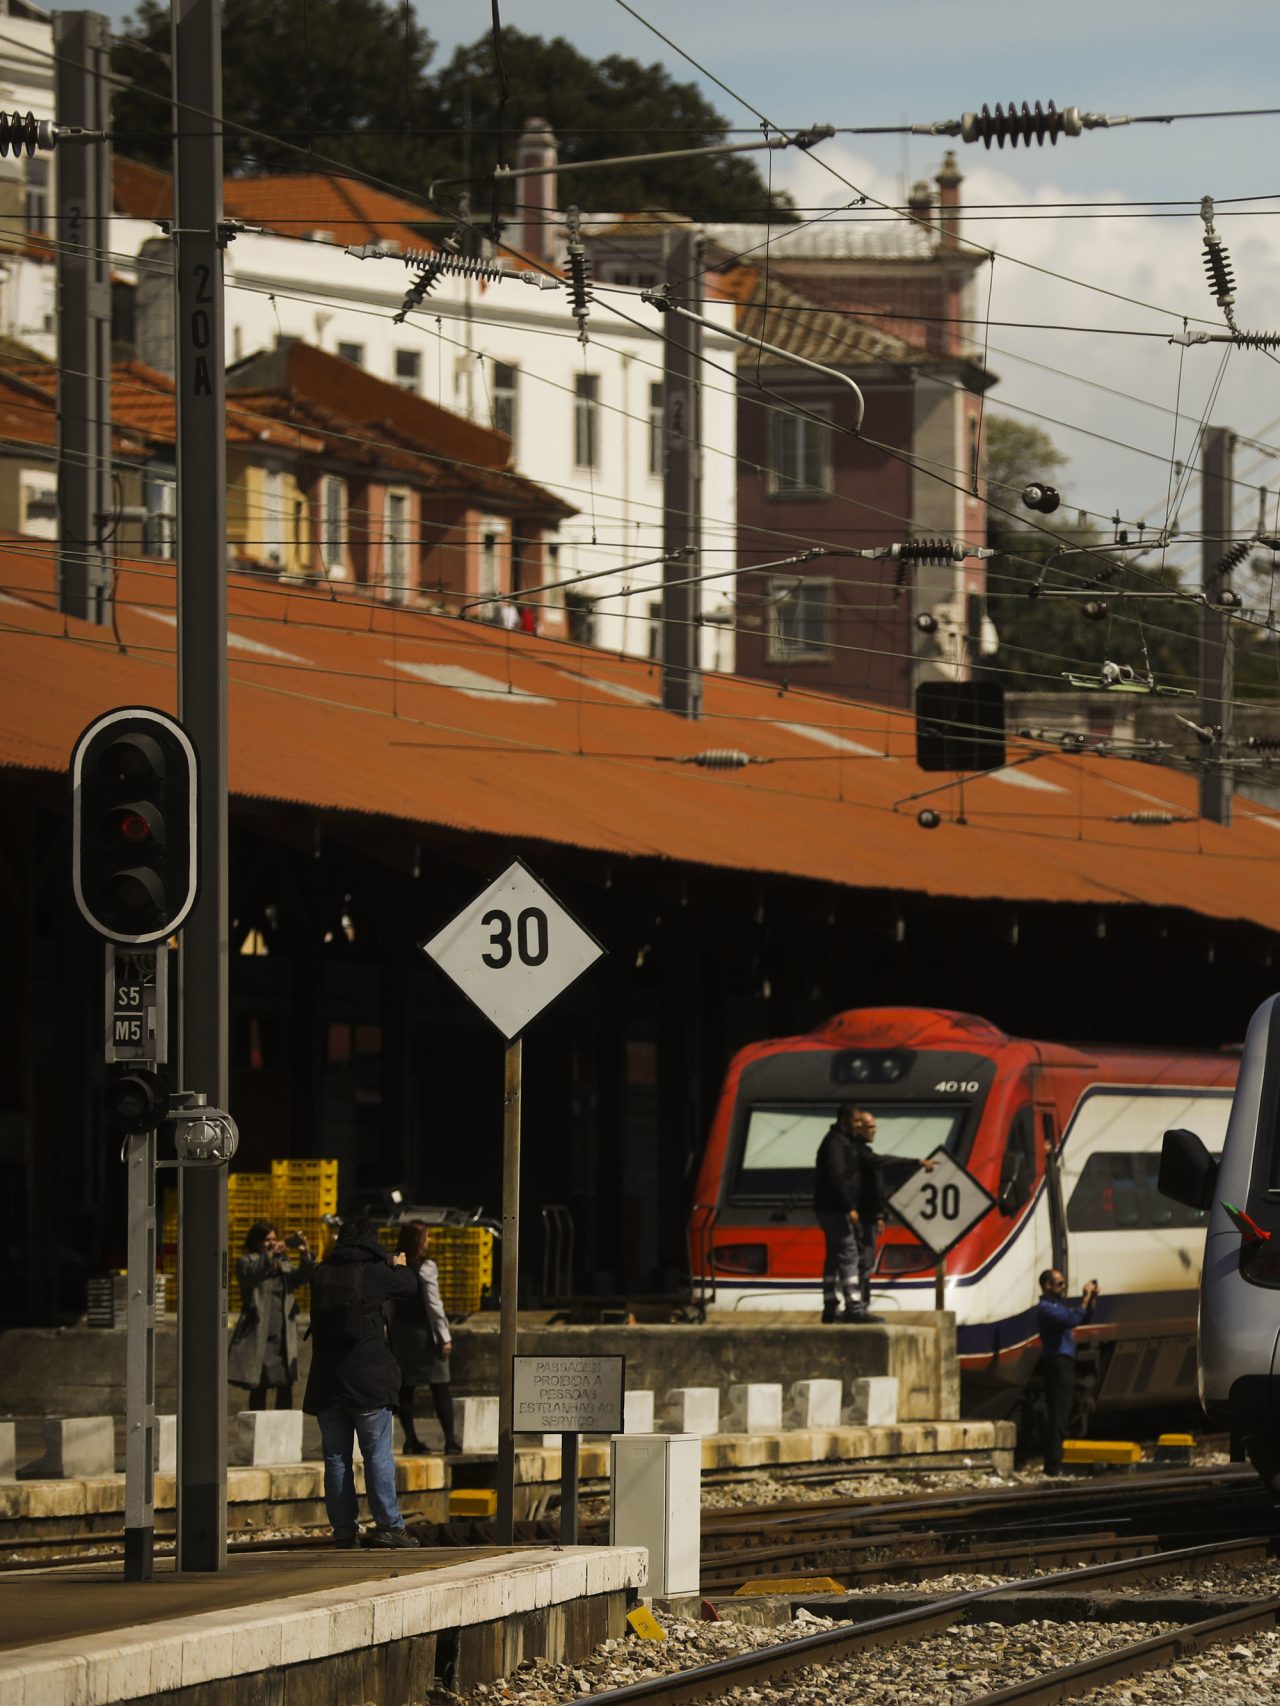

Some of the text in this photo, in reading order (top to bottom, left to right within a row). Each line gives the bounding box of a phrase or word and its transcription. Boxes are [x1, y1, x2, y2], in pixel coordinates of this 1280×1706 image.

[480, 907, 549, 970] 30
[118, 986, 140, 1006] S5
[115, 1021, 141, 1041] M5
[934, 1080, 979, 1093] 4010
[919, 1183, 960, 1220] 30
[594, 1375, 603, 1386] A
[539, 1388, 597, 1401] PESSOAS
[519, 1402, 616, 1415] ESTRANHAS AO
